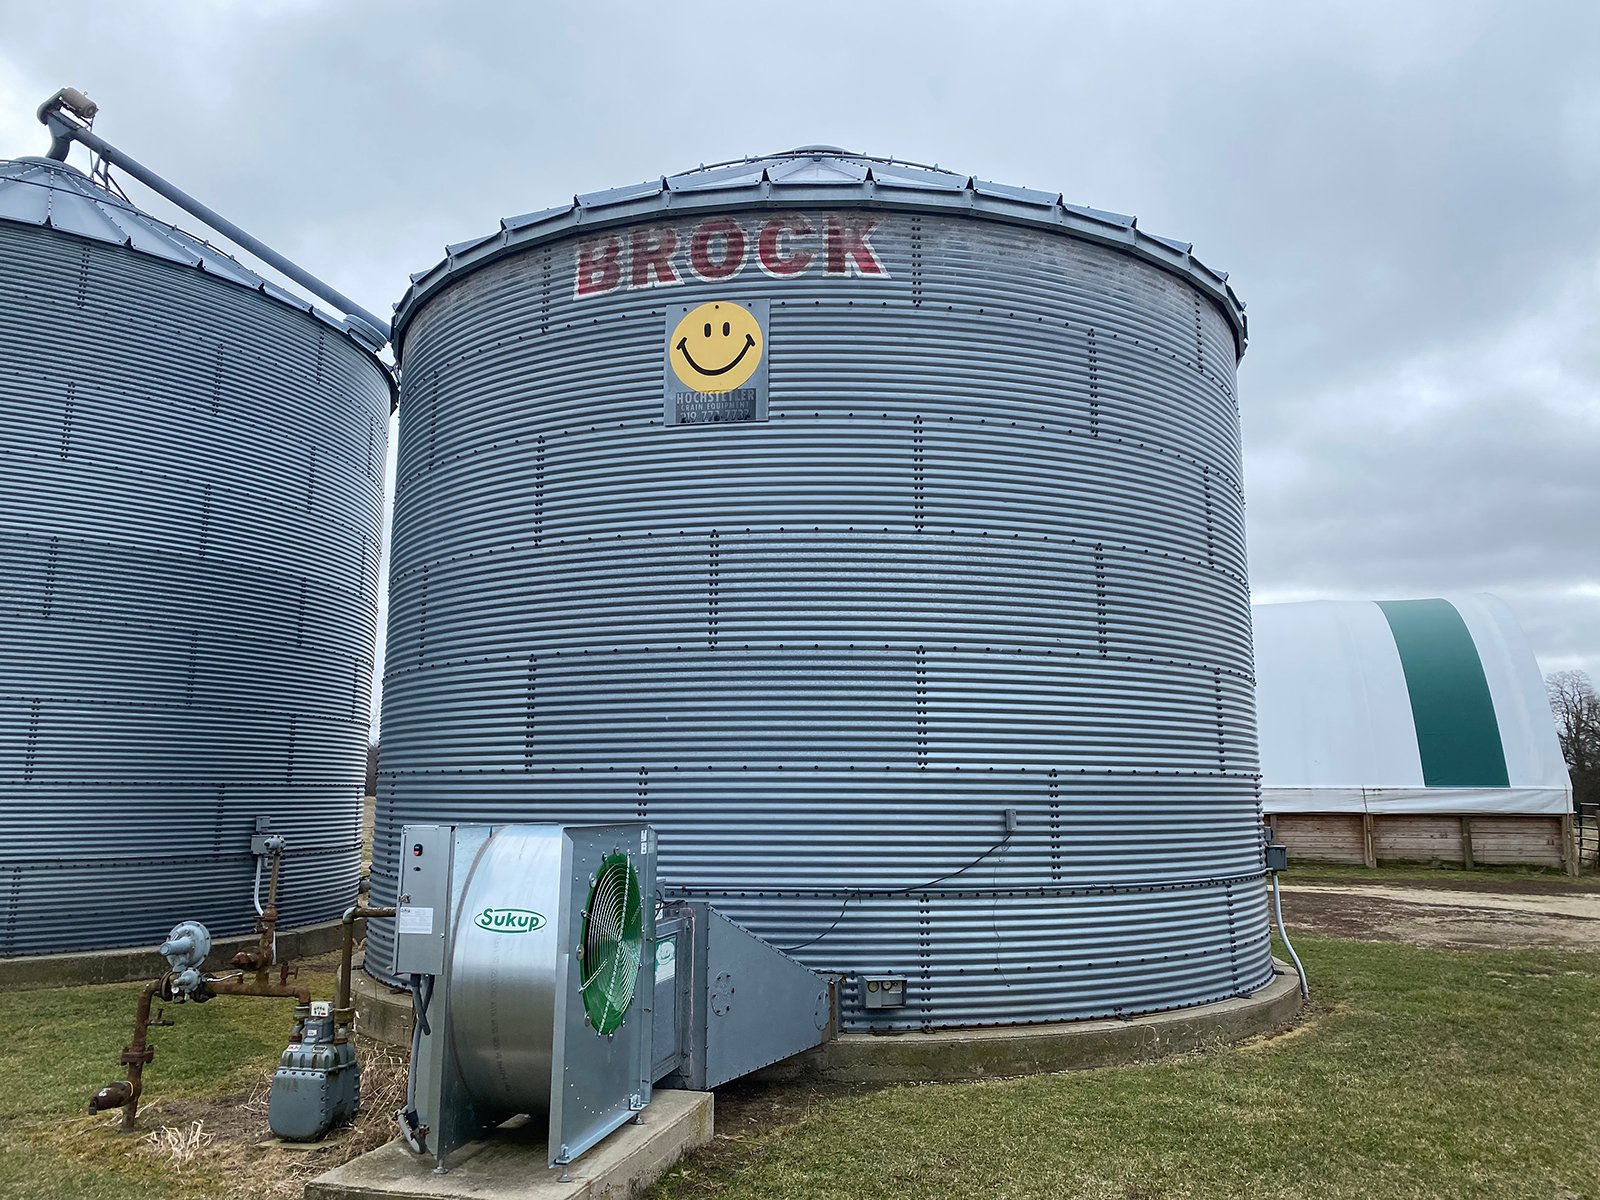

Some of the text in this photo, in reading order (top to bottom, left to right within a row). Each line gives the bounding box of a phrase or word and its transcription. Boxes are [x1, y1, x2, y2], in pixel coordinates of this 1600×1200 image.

[573, 212, 892, 300] BROCK
[707, 402, 749, 410] EQUIPMENT
[481, 908, 540, 932] Sukup
